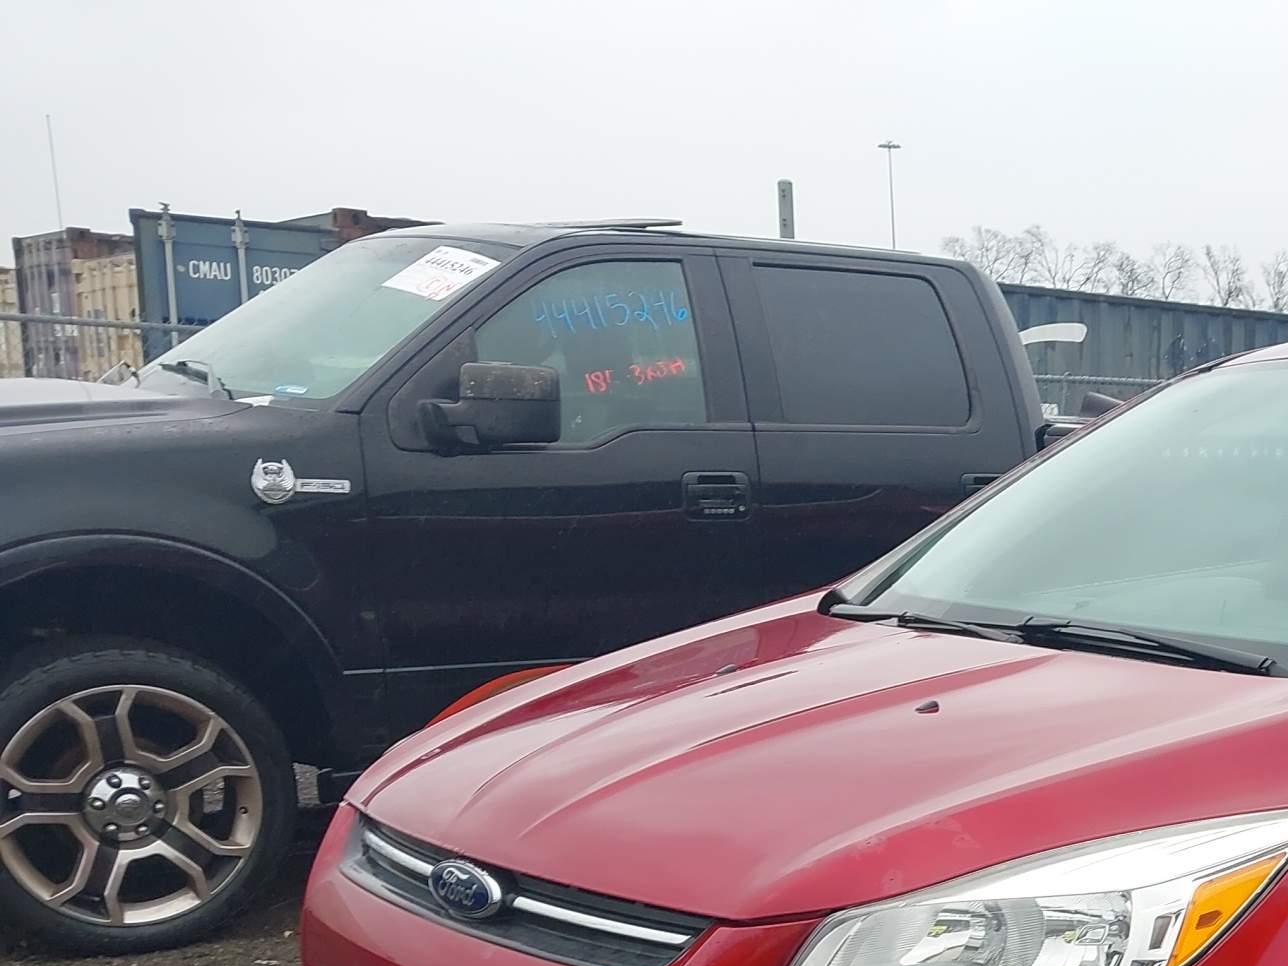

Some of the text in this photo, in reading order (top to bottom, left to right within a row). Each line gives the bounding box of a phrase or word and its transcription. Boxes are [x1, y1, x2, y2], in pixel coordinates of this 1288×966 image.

[188, 260, 300, 287] CMAU 8030
[438, 866, 479, 906] Ford
